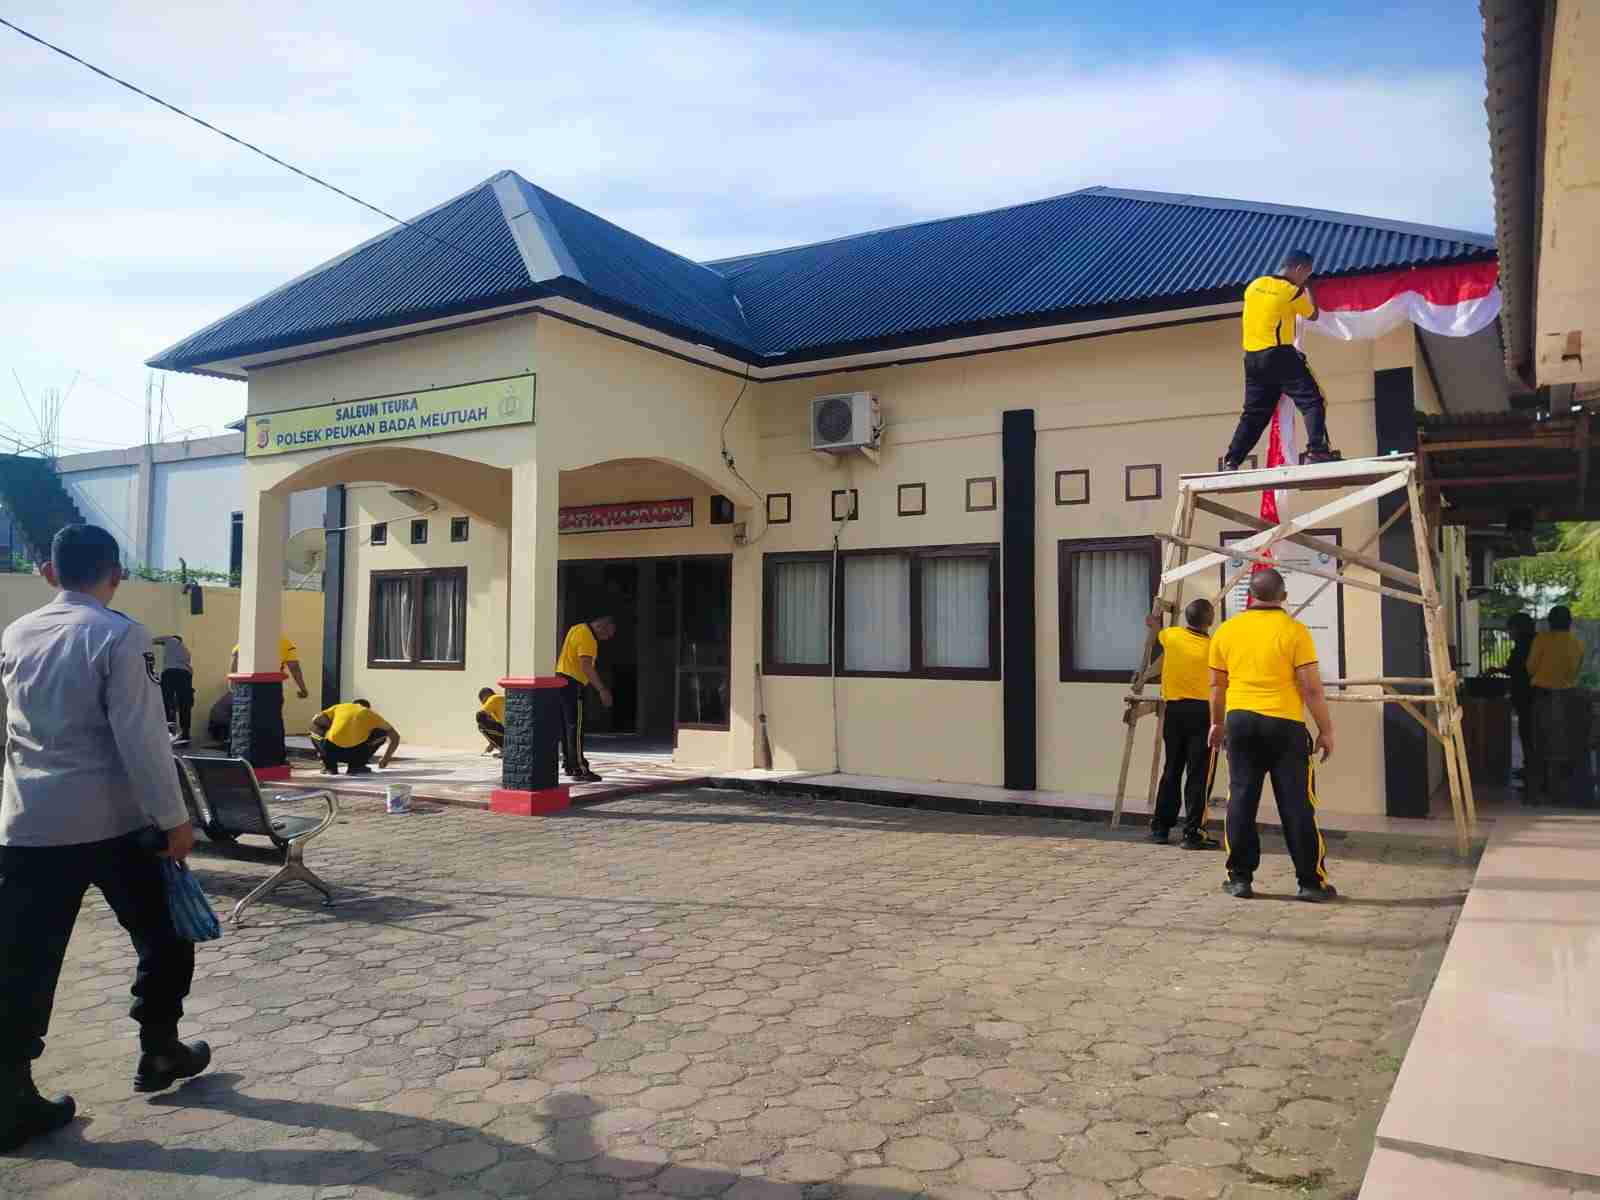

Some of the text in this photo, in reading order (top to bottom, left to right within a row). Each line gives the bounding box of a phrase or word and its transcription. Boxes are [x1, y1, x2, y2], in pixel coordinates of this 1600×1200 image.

[336, 398, 418, 421] SALEUM TEUKA
[276, 407, 488, 446] POLSEK PEUKAN BADA MEUTUAH
